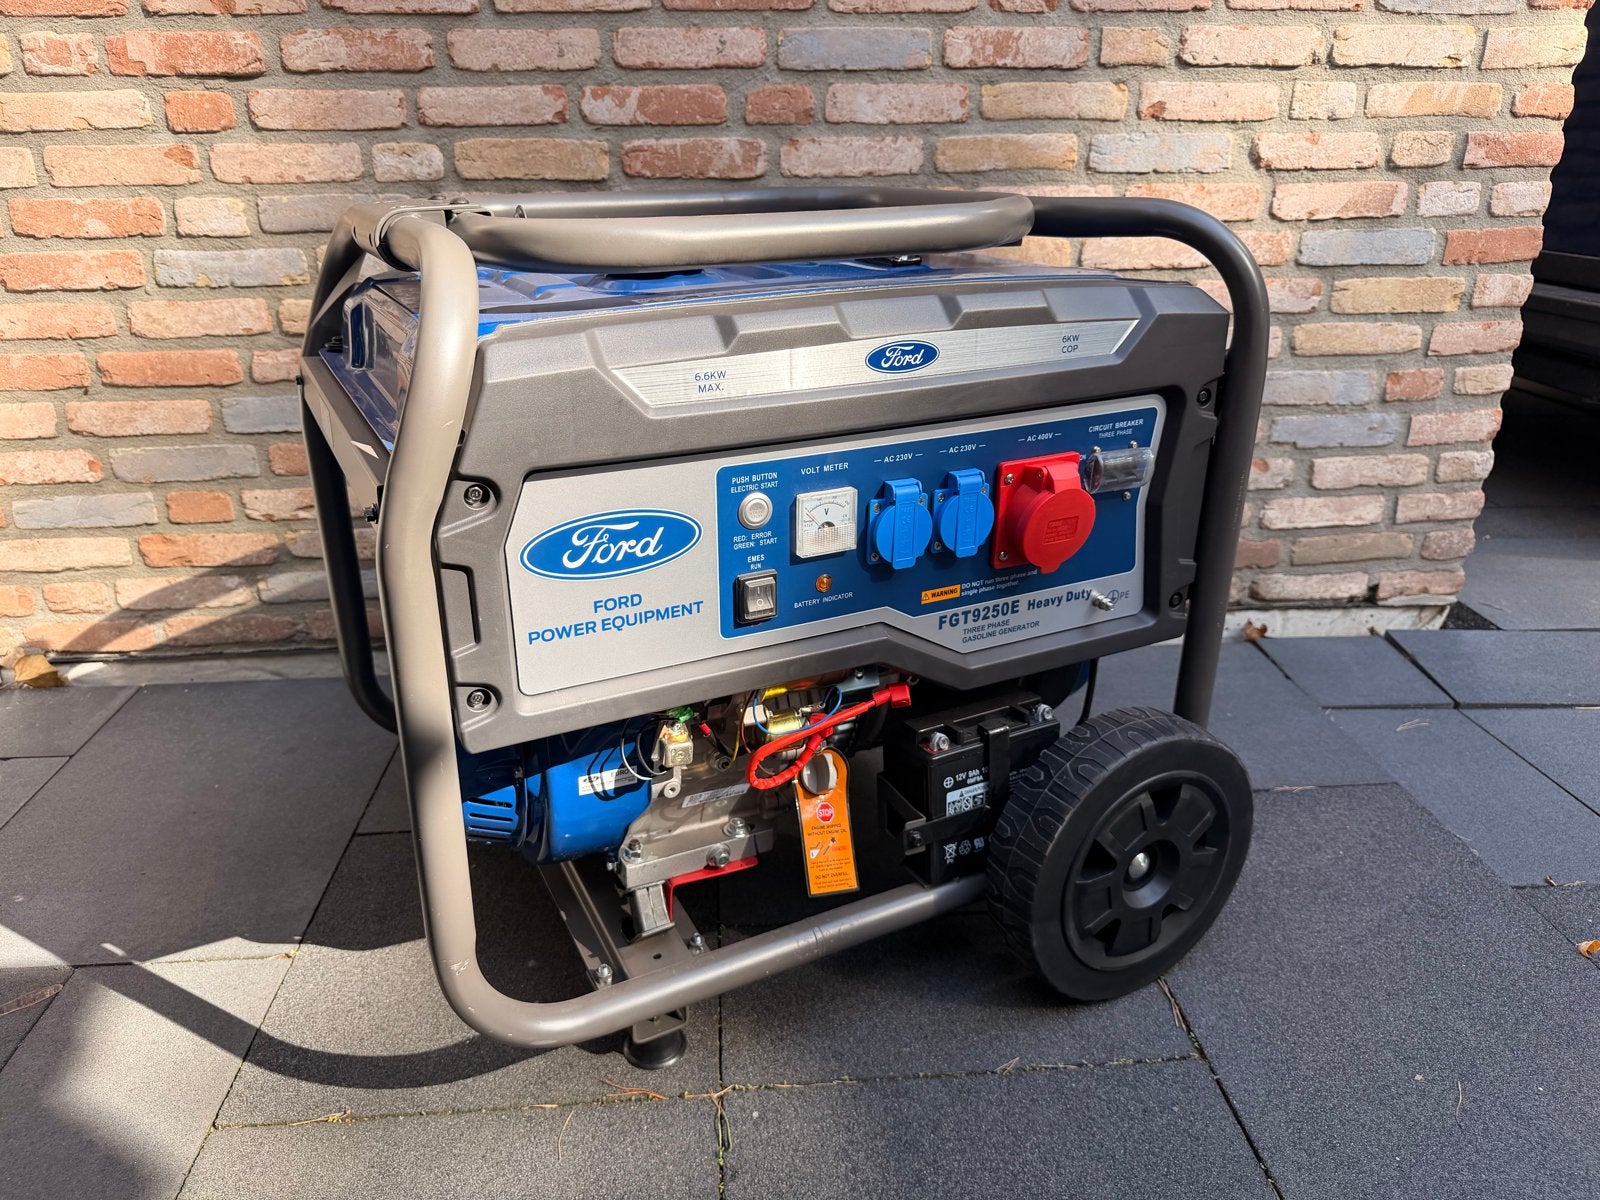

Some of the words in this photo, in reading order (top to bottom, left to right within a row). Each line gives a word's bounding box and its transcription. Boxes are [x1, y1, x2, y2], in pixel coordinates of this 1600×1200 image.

[1062, 334, 1080, 343] 6KW
[1061, 344, 1079, 354] COP
[881, 345, 925, 368] Ford
[694, 370, 727, 382] 6.6KW
[698, 384, 725, 394] MAX.
[1088, 423, 1113, 433] CIRCUIT
[1114, 418, 1144, 429] BREAKER
[1026, 434, 1037, 442] AC
[1038, 432, 1054, 441] 400V
[1098, 430, 1115, 439] THREE
[1116, 428, 1133, 437] PHASE
[948, 446, 959, 454] AC
[960, 443, 977, 452] 230V
[883, 455, 895, 463] AC
[896, 453, 913, 462] 230V
[801, 466, 820, 475] VOLT
[823, 462, 849, 472] METER
[731, 476, 750, 484] PUSH
[751, 472, 778, 482] BUTTON
[730, 484, 759, 494] ELECTRIC
[760, 480, 779, 490] START
[824, 507, 830, 516] V
[733, 535, 748, 543] RED:
[751, 530, 772, 540] ERROR
[562, 520, 665, 569] Ford
[733, 541, 756, 551] GREEN:
[759, 537, 778, 546] START
[747, 554, 765, 563] EMES
[971, 579, 984, 588] NOT
[1010, 573, 1027, 582] phase
[1027, 568, 1038, 576] and
[931, 587, 958, 599] WARNING
[960, 588, 978, 597] single
[979, 584, 996, 594] phase
[1120, 590, 1130, 599] PE
[593, 593, 643, 614] FORD
[794, 599, 820, 609] BATTERY
[822, 591, 853, 603] INDICATOR
[938, 599, 1020, 630] FGT9250E
[1027, 595, 1064, 611] Heavy
[1065, 588, 1093, 602] Duty
[528, 620, 597, 645] POWER
[601, 600, 704, 632] EQUIPMENT
[963, 625, 986, 635] THREE
[987, 619, 1010, 629] PHASE
[962, 630, 997, 643] GASOLINE
[998, 620, 1040, 635] GENERATOR
[955, 771, 967, 782] 12V
[818, 808, 834, 817] STOP
